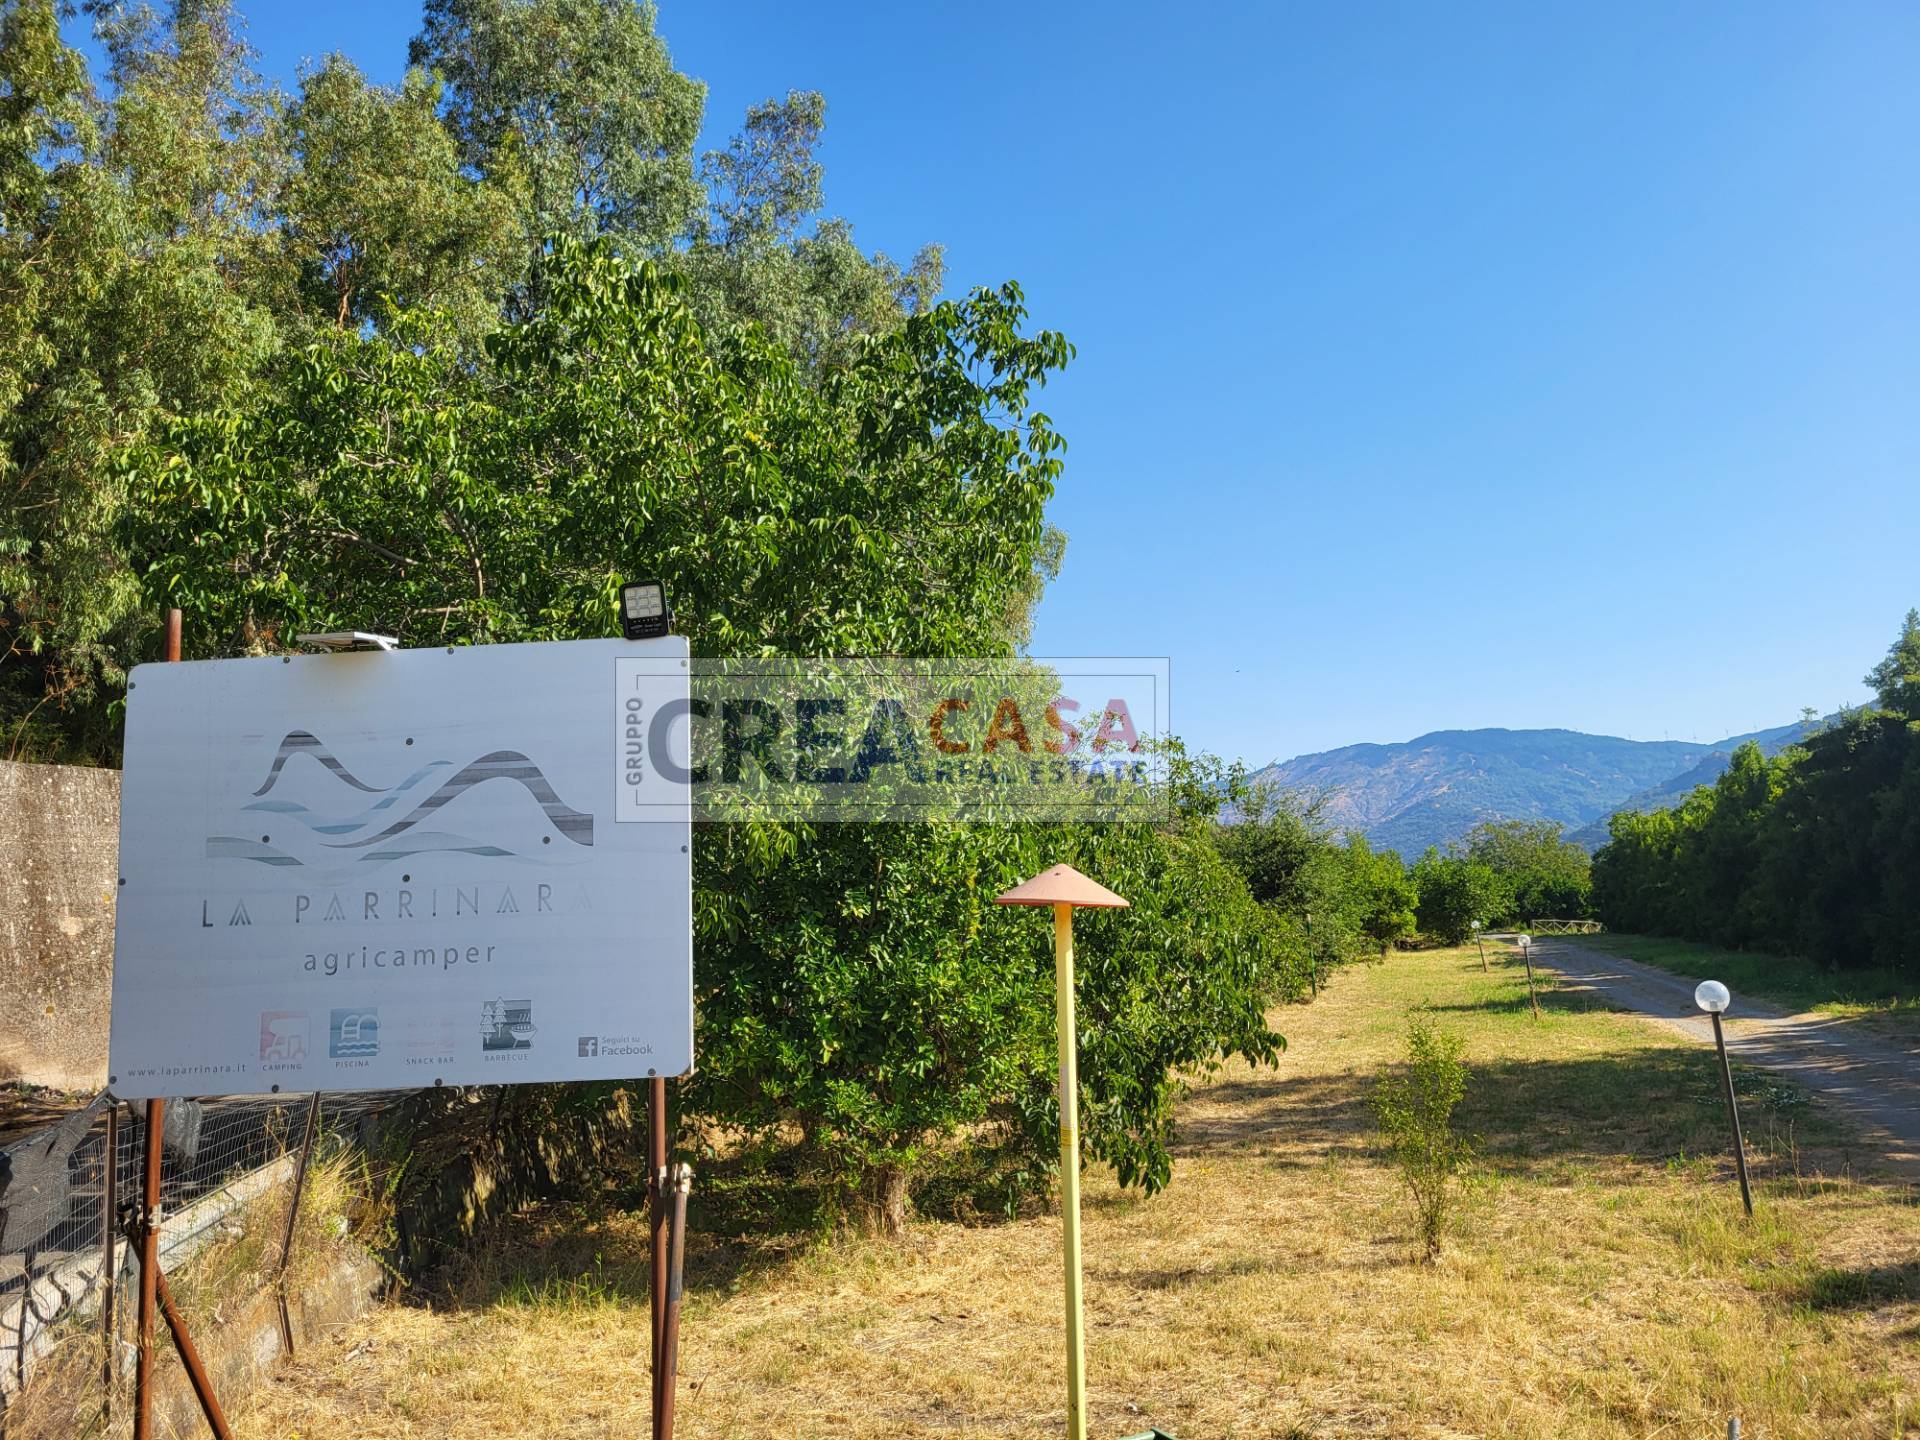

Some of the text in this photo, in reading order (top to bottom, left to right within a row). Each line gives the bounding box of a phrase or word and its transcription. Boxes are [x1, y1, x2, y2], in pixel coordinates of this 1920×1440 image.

[202, 883, 593, 928] LA PARRINARA
[304, 945, 496, 976] agricamper
[601, 1044, 654, 1056] Facebook
[335, 1060, 370, 1069] PISCINA
[406, 1056, 455, 1065] SNACK BAR
[127, 1064, 247, 1077] www.laparrinara.it
[262, 1063, 302, 1072] CAMPING
